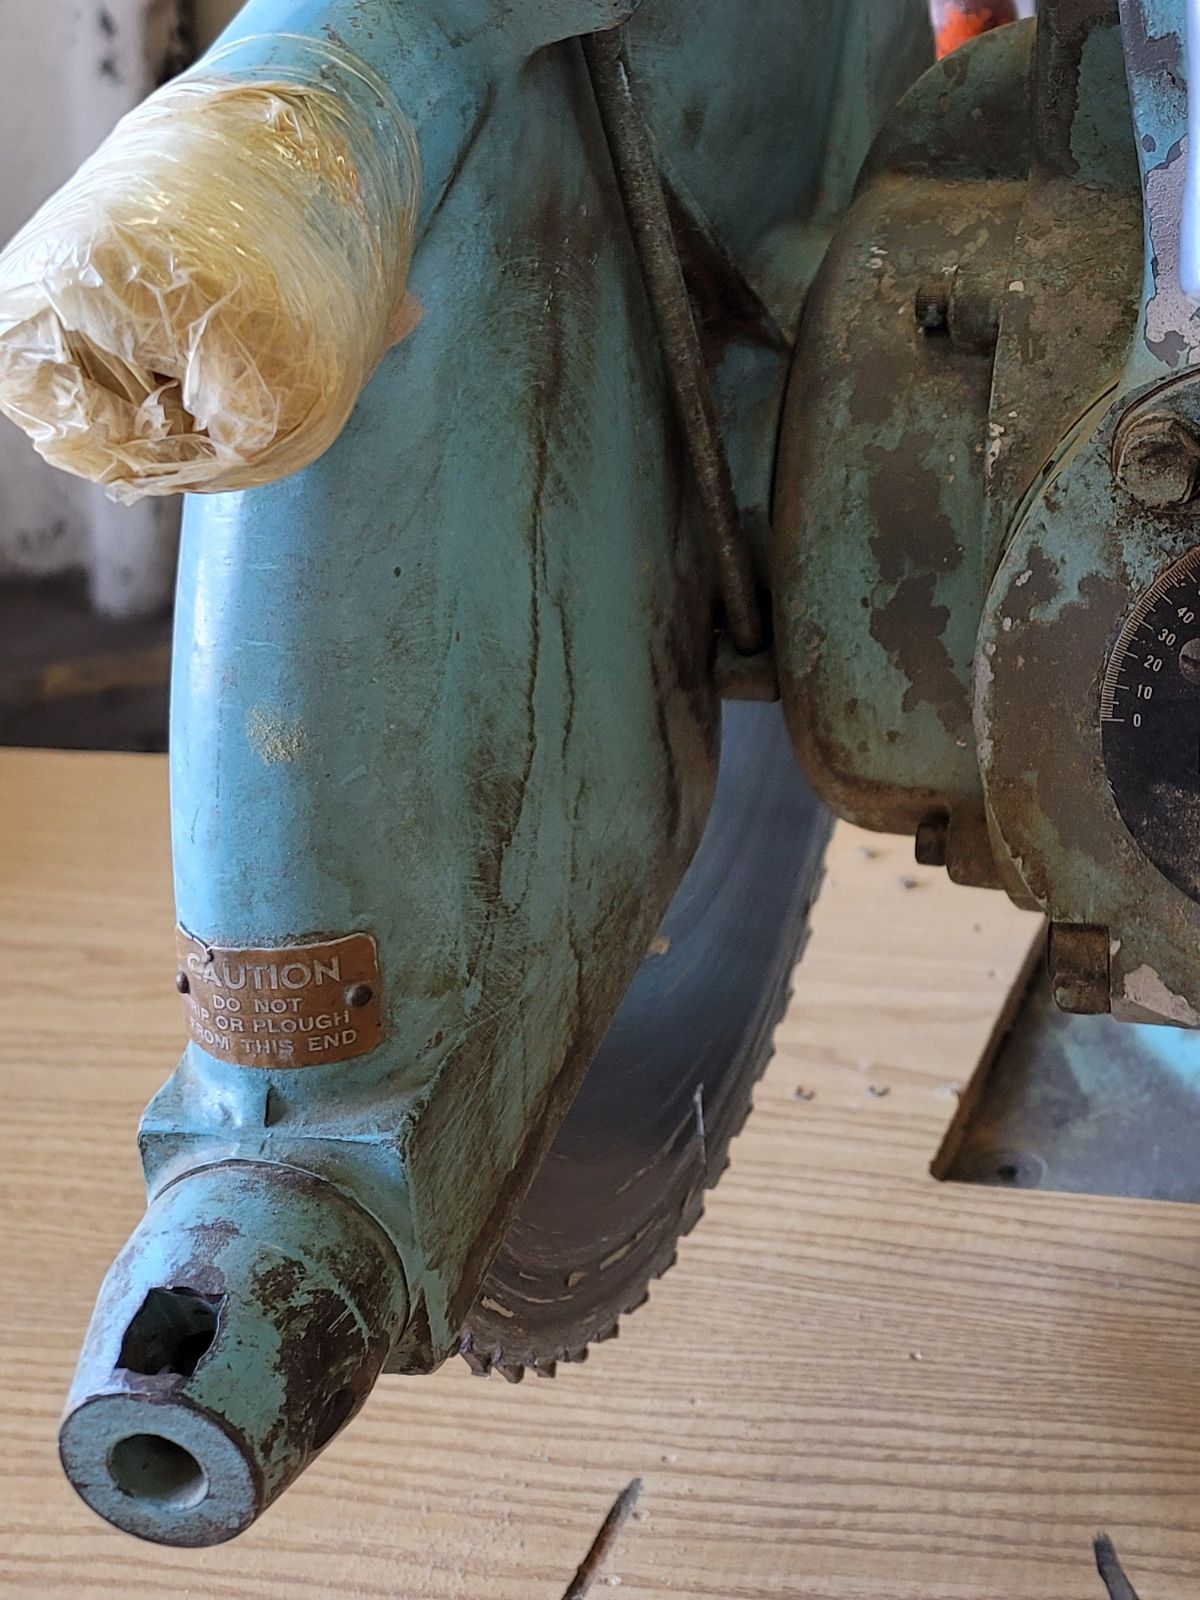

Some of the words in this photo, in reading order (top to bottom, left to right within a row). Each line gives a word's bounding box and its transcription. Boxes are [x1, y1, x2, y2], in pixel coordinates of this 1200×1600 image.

[1176, 606, 1195, 624] 40
[1158, 628, 1176, 646] 30
[1143, 655, 1163, 672] 20
[1137, 684, 1153, 700] 10
[1133, 713, 1142, 728] 0
[186, 953, 342, 990] CAUTION
[213, 995, 240, 1013] DO
[254, 997, 303, 1014] NOT
[215, 1016, 244, 1033] OR
[253, 1010, 350, 1033] PLOUGH
[190, 1019, 231, 1050] FROM
[241, 1038, 295, 1054] THIS
[308, 1029, 358, 1052] END
